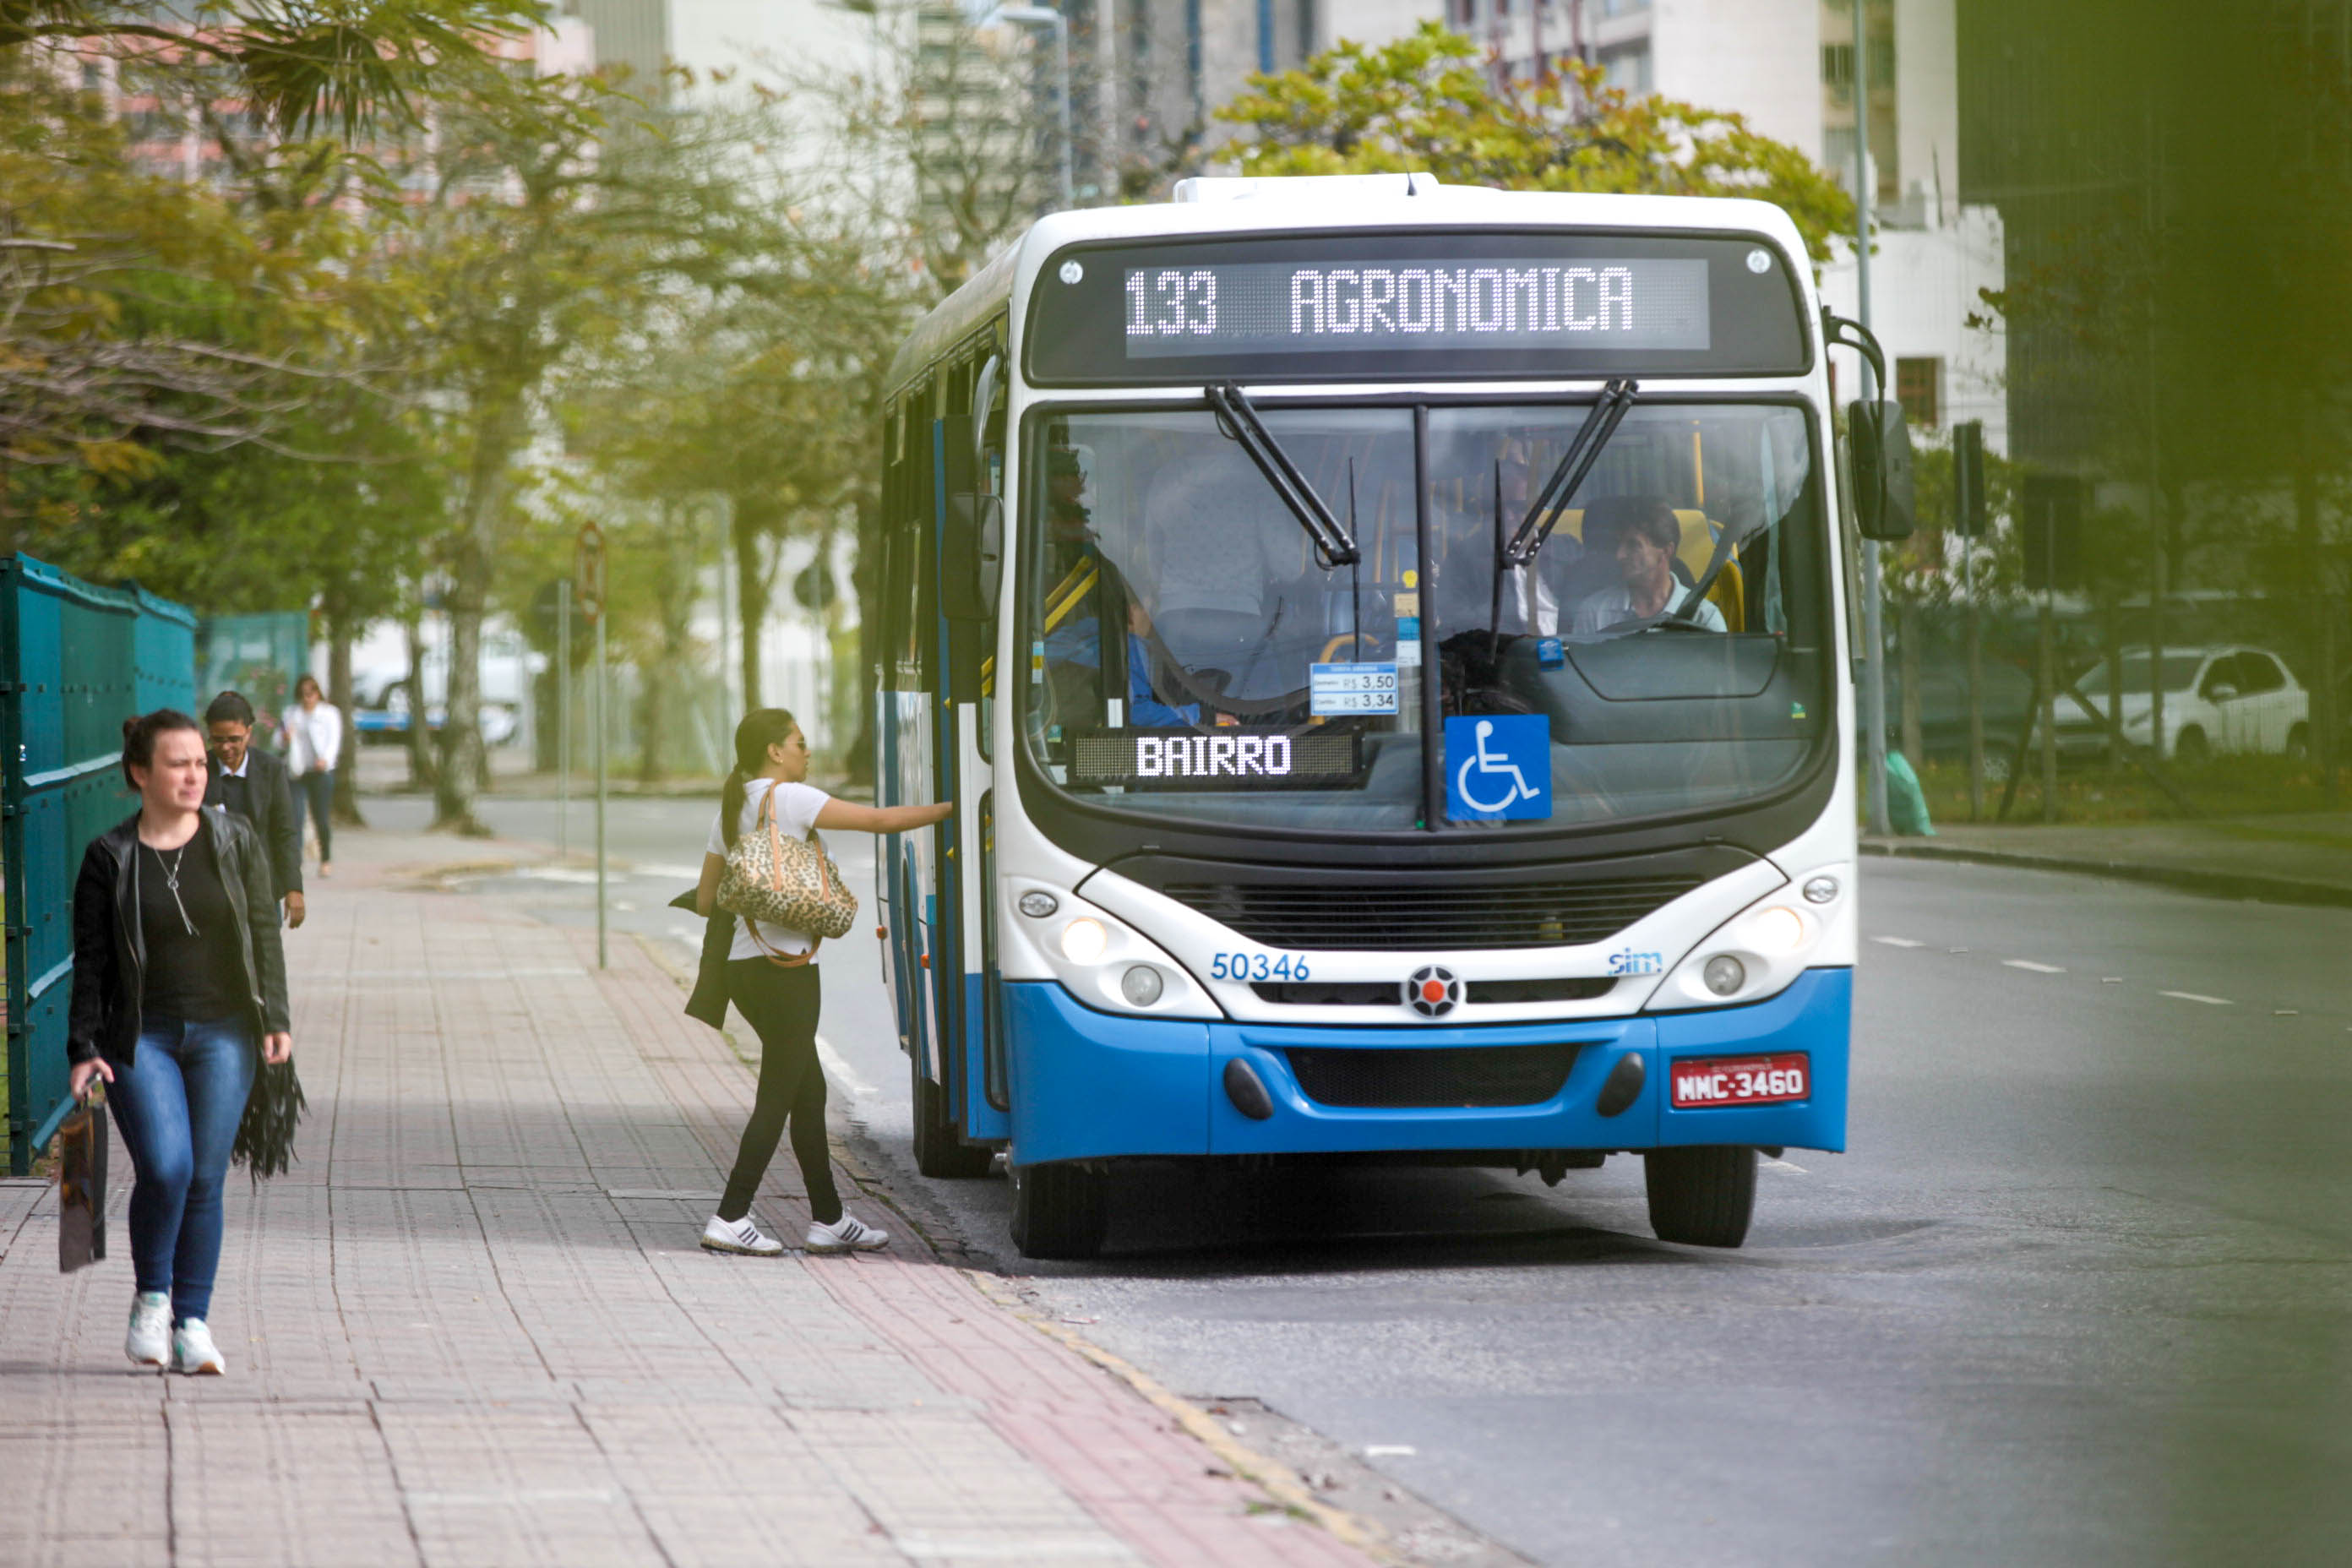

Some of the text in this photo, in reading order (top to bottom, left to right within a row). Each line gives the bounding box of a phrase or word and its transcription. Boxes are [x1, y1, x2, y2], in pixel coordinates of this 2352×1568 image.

[1125, 266, 1632, 335] 133 AGRONOMICA
[1363, 675, 1394, 690] 3,50
[1363, 694, 1394, 708] 3,34
[1136, 735, 1291, 776] BAIRRO
[1210, 952, 1310, 981] 50346
